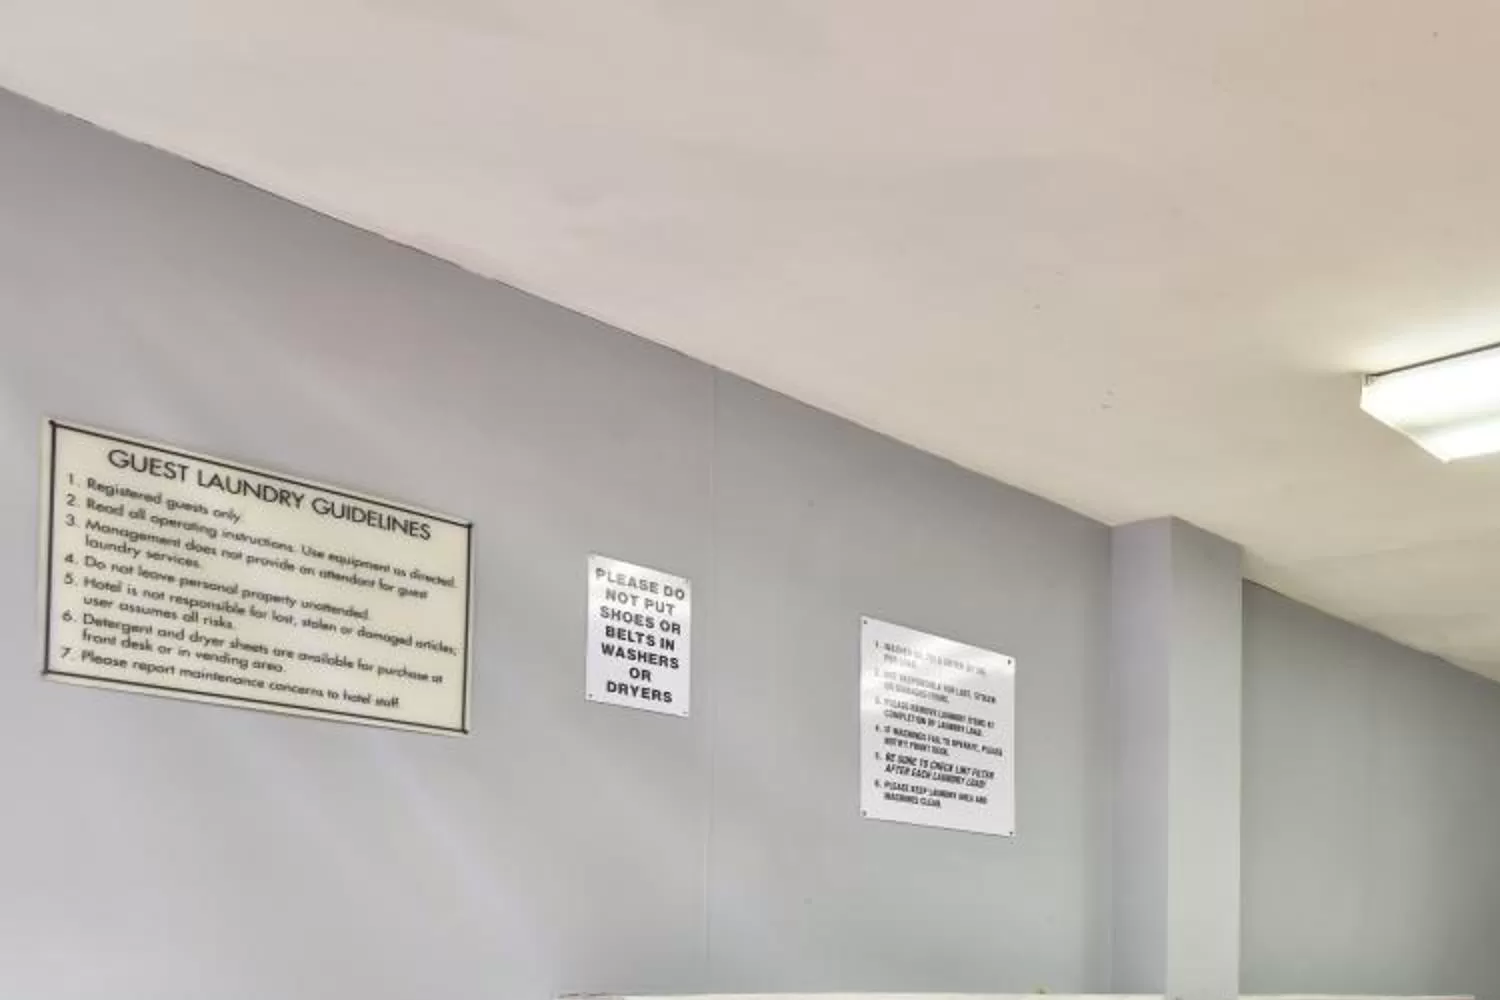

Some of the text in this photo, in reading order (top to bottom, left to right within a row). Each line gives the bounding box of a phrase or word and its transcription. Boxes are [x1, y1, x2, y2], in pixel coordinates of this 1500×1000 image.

[86, 476, 162, 507] Registered
[166, 496, 208, 517] guests
[107, 446, 431, 541] GUEST LAUNDRY GUIDELINES
[85, 535, 140, 559] laundry
[86, 497, 124, 517] Read
[128, 505, 145, 521] all
[150, 510, 217, 538] operating
[301, 544, 324, 559] Use
[328, 549, 390, 575] equipment
[392, 566, 406, 576] as
[85, 518, 180, 550] Management
[185, 538, 216, 555] does
[221, 546, 242, 561] not
[246, 551, 295, 573] provide
[300, 564, 314, 576] an
[319, 566, 375, 588] attendant
[378, 578, 394, 592] for
[397, 584, 427, 601] guest
[84, 555, 106, 570] Do
[111, 560, 133, 575] not
[138, 565, 174, 582] leave
[179, 573, 237, 597] personal
[241, 587, 296, 608] property
[596, 567, 685, 600] PLEASE DO
[84, 595, 112, 608] user
[119, 601, 177, 619] assumes
[182, 609, 198, 623] all
[84, 575, 121, 593] Hotel
[127, 584, 137, 596] is
[142, 587, 164, 601] not
[169, 591, 245, 617] responsible
[250, 604, 267, 619] for
[272, 610, 297, 627] lost,
[301, 615, 336, 632] stolen
[340, 625, 352, 635] or
[357, 625, 412, 649] damaged
[606, 588, 675, 615] NOT PUT
[600, 605, 681, 635] SHOES OR
[605, 625, 675, 651] BELTS IN
[82, 629, 116, 645] front
[121, 635, 152, 652] desk
[157, 644, 171, 654] or
[178, 646, 190, 657] in
[195, 647, 248, 669] vending
[83, 612, 152, 637] Detergent
[157, 624, 185, 640] and
[190, 630, 224, 648] dryer
[230, 636, 268, 654] sheets
[272, 647, 293, 658] are
[298, 648, 354, 668] available
[357, 657, 373, 671] for
[376, 660, 428, 683] purchase
[432, 674, 443, 683] at
[601, 642, 679, 669] WASHERS
[81, 649, 127, 667] Please
[133, 658, 174, 677] report
[179, 665, 264, 688] maintenance
[269, 681, 323, 697] concerns
[327, 688, 338, 699] to
[343, 688, 371, 704] hotel
[606, 680, 672, 703] DRYERS
[629, 667, 651, 681] OR
